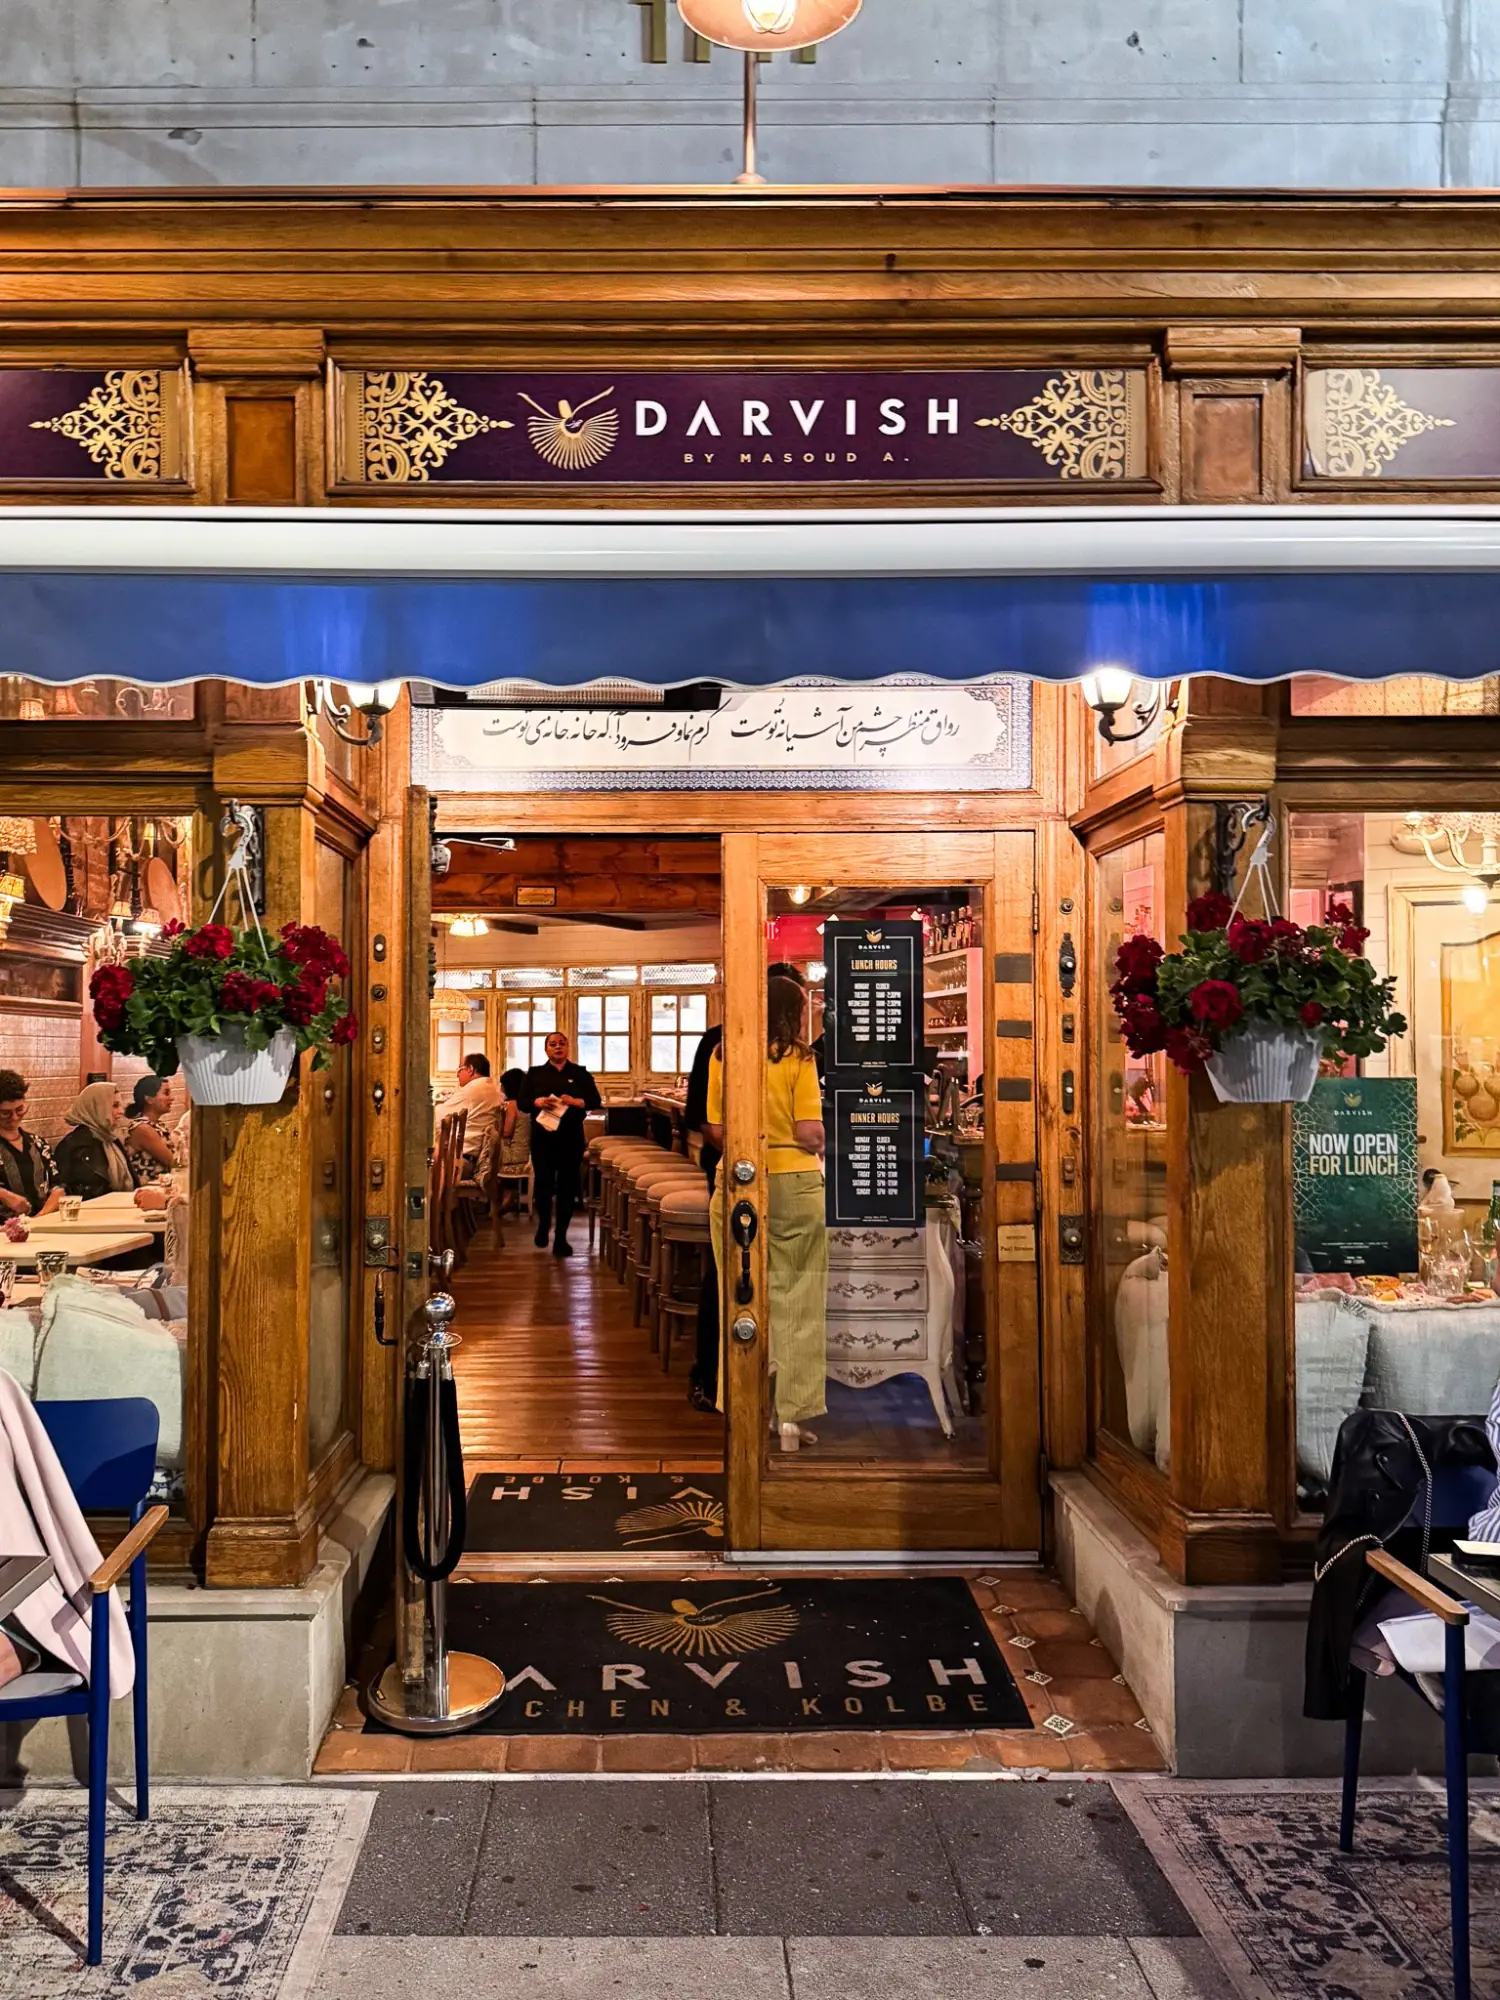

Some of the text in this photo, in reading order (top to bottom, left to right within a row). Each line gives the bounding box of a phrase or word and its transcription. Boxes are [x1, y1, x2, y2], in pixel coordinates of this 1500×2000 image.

[635, 398, 958, 435] DARVISH
[684, 452, 909, 463] BY MASOUD A.
[851, 959, 898, 970] LUNCH HOURS
[850, 1112, 900, 1124] DINNER HOURS
[1309, 1133, 1398, 1155] NOW OPEN
[1309, 1155, 1399, 1176] FOR LUNCH
[491, 1486, 715, 1501] VISH
[506, 1657, 987, 1691] ARVISH
[525, 1694, 988, 1718] CHEN & KOLBE
